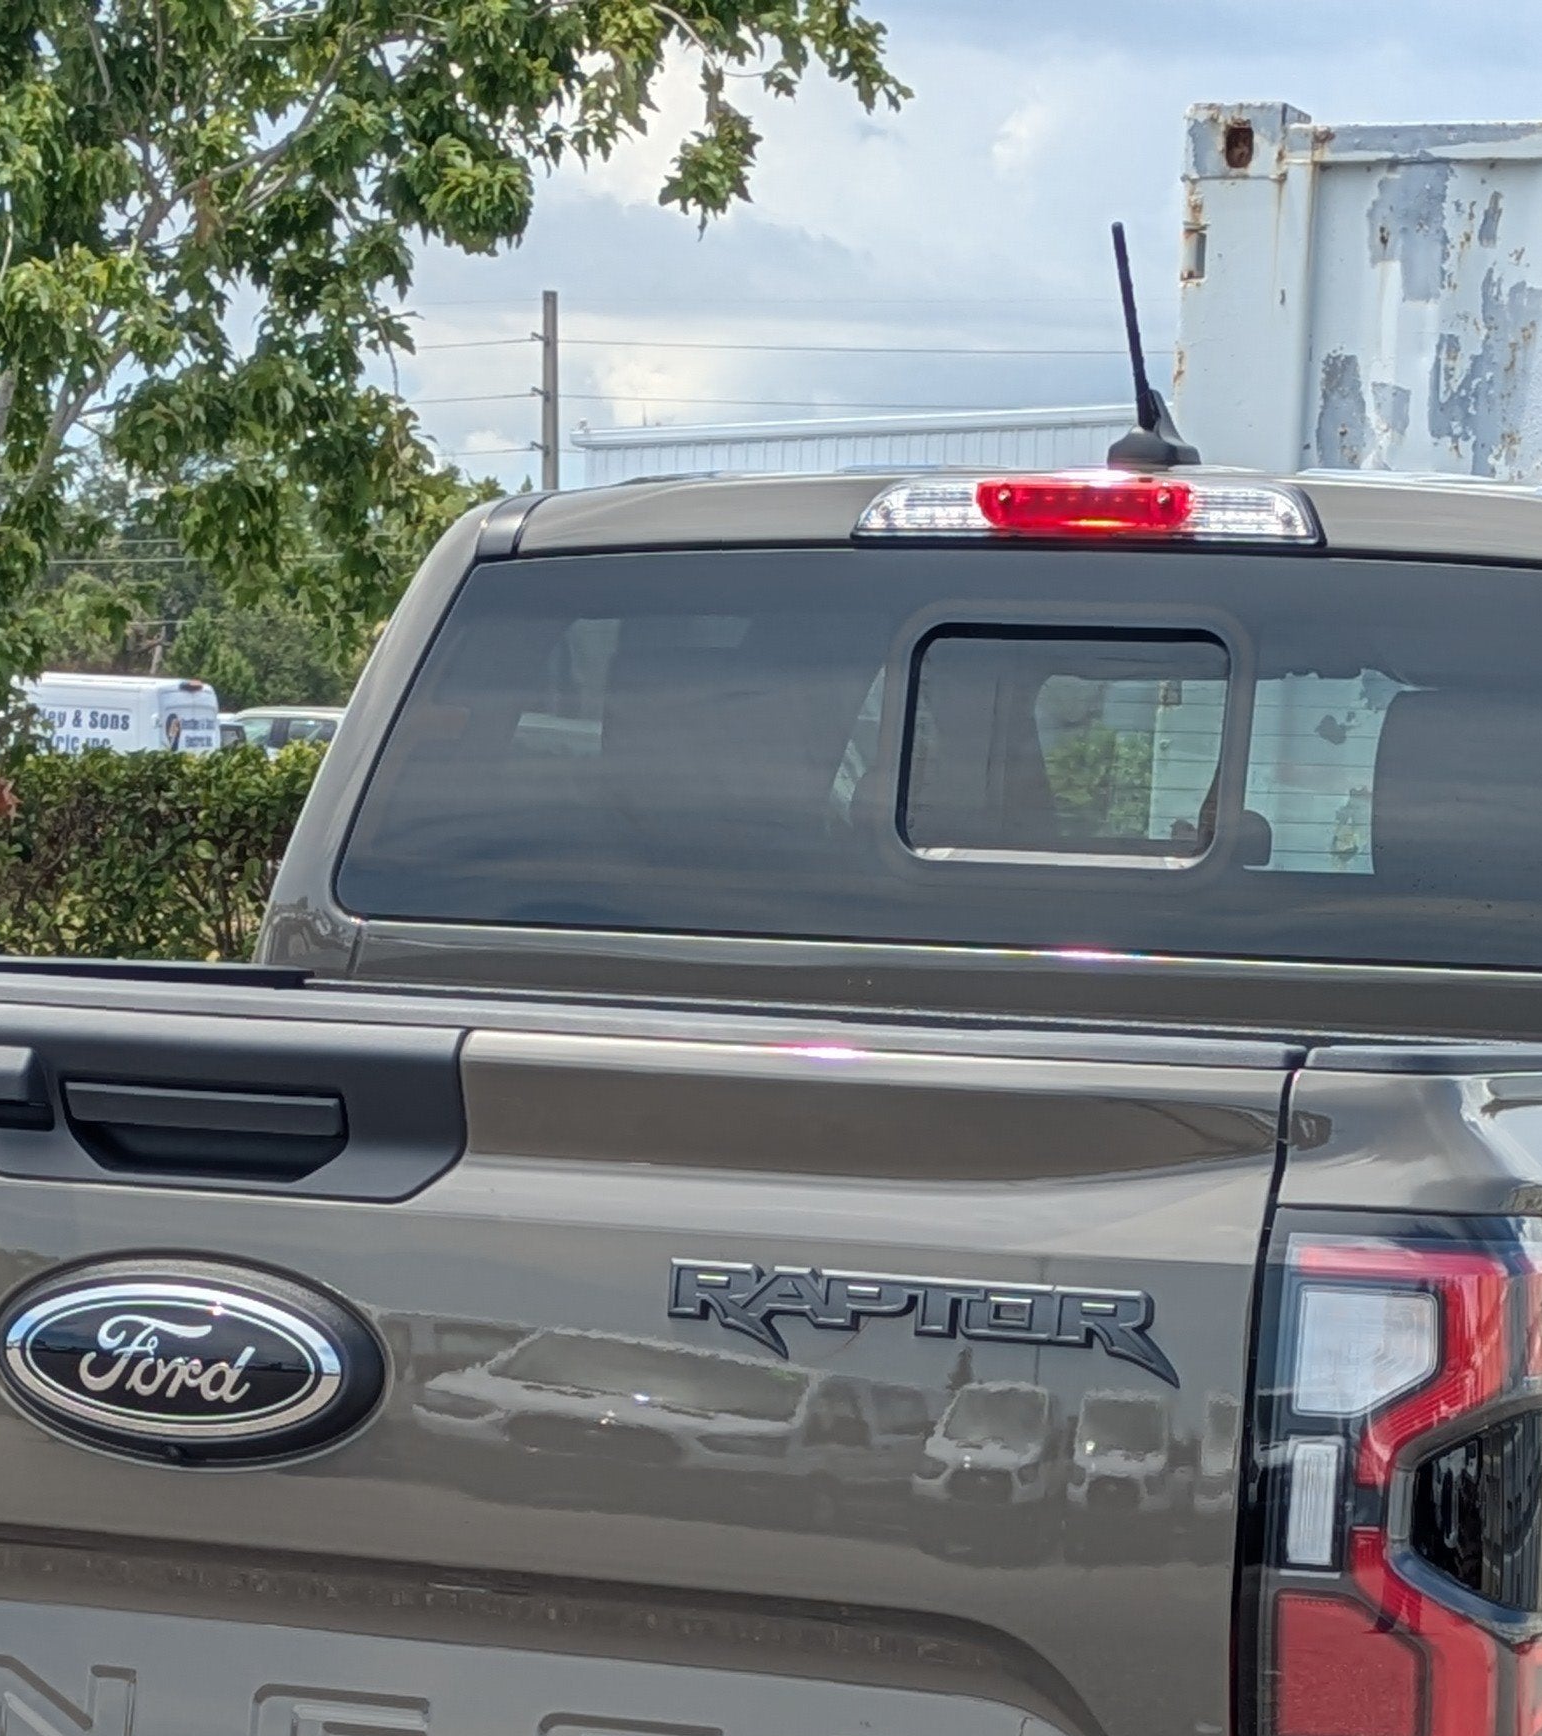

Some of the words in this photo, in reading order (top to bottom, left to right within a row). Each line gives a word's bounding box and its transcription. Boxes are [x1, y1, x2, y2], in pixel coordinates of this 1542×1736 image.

[72, 709, 83, 728] &
[88, 710, 131, 731] Sons
[76, 1314, 257, 1406] Ford
[668, 1256, 1181, 1389] RAPTOR
